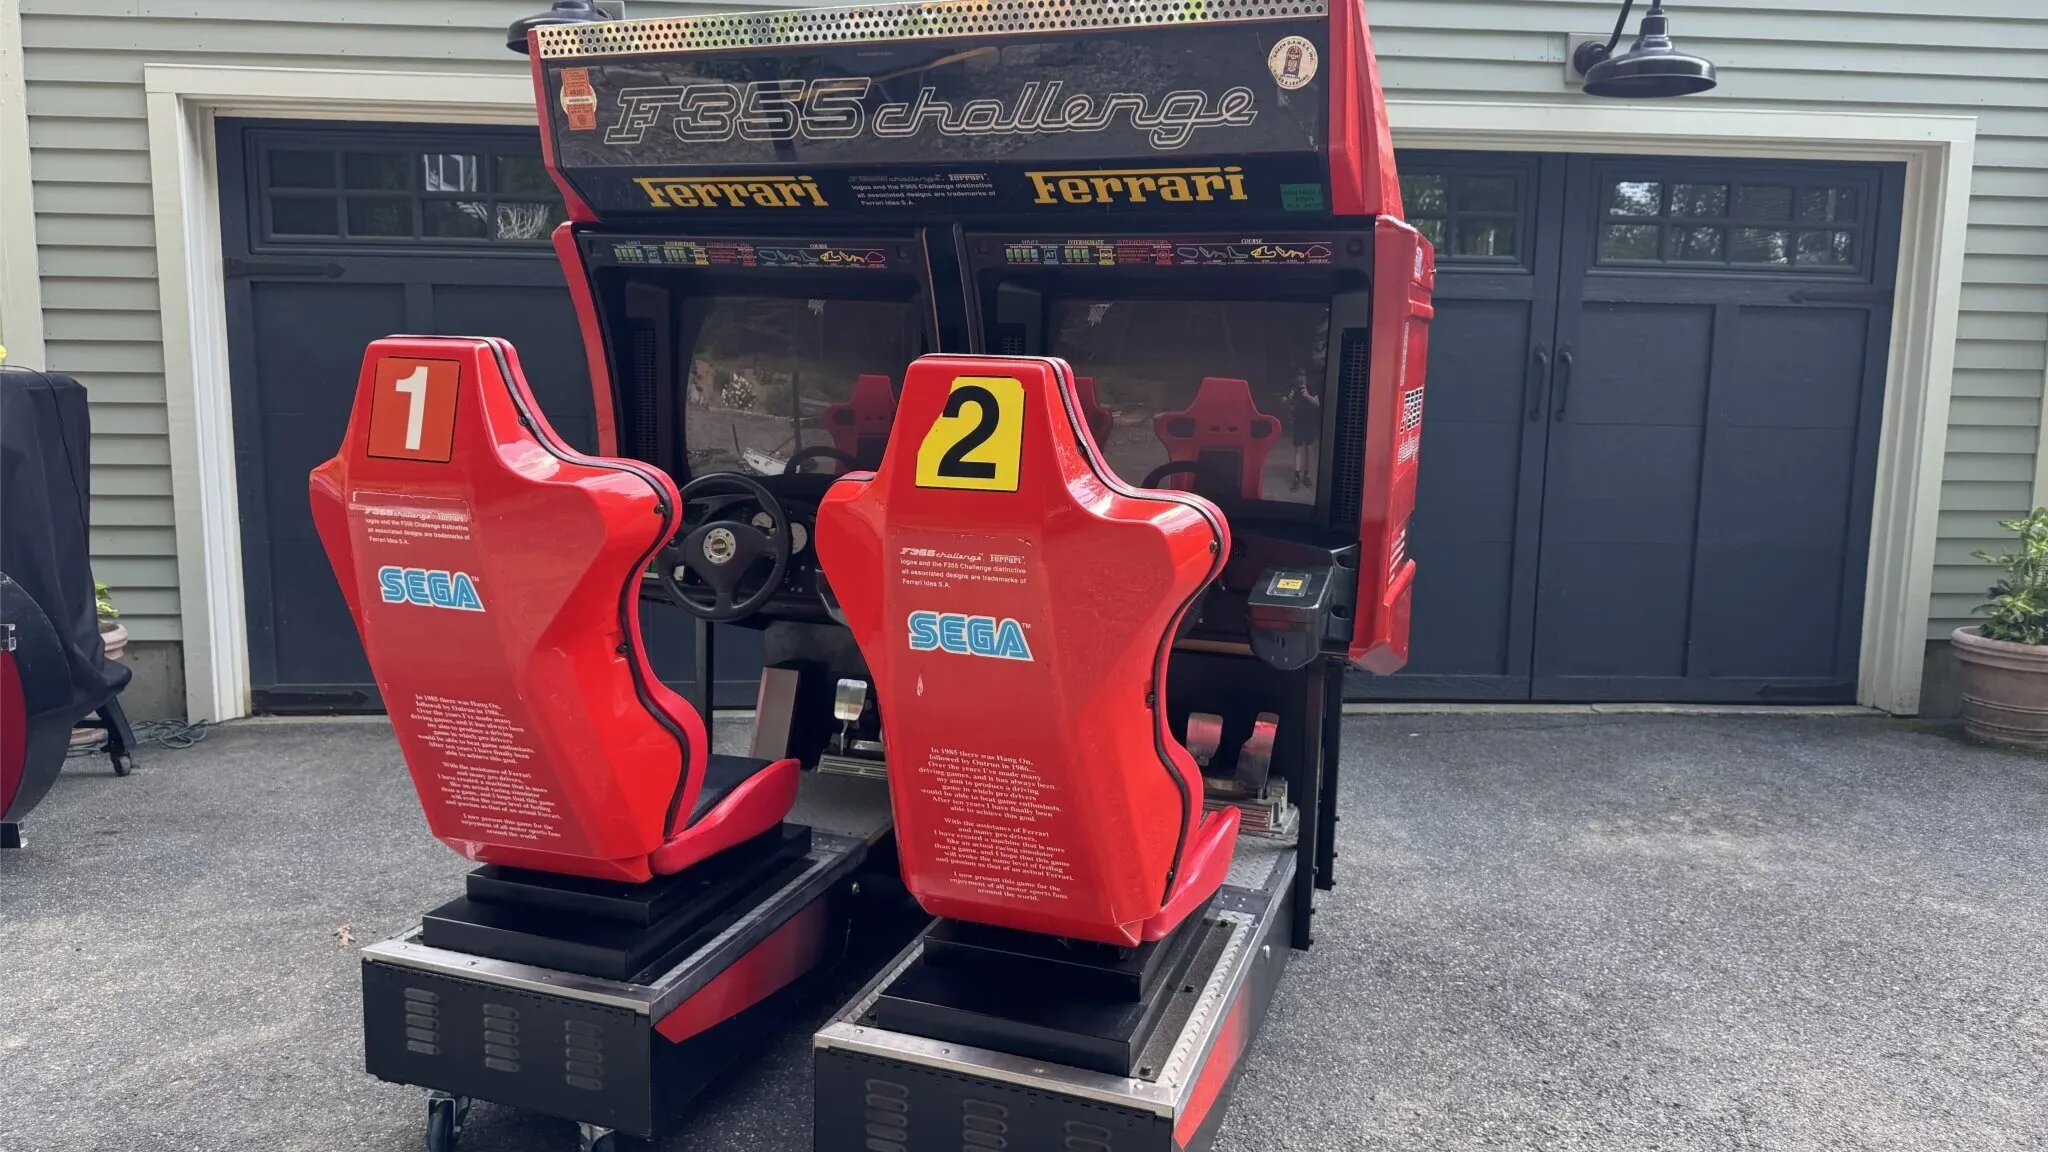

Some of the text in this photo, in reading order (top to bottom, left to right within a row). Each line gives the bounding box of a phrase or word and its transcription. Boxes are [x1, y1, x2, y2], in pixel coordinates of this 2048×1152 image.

[604, 77, 871, 145] F355
[872, 81, 1258, 149] challenge
[632, 176, 829, 208] Ferrari
[1025, 166, 1249, 204] Ferrari
[395, 366, 428, 450] 1
[937, 385, 1000, 479] 2
[900, 558, 918, 566] logos
[960, 563, 992, 572] Challenge
[993, 566, 1026, 574] distinctive
[946, 572, 968, 580] designs
[982, 575, 1018, 583] trademarks
[378, 564, 486, 612] SEGA
[908, 610, 1034, 661] SEGA
[929, 754, 960, 762] followed
[972, 760, 1000, 768] Outrun
[996, 756, 1018, 764] Hang
[918, 767, 946, 776] driving
[1010, 779, 1036, 787] always
[1037, 782, 1056, 790] been
[974, 782, 1004, 790] produce
[1012, 786, 1039, 795] driving
[1020, 774, 1041, 782] many
